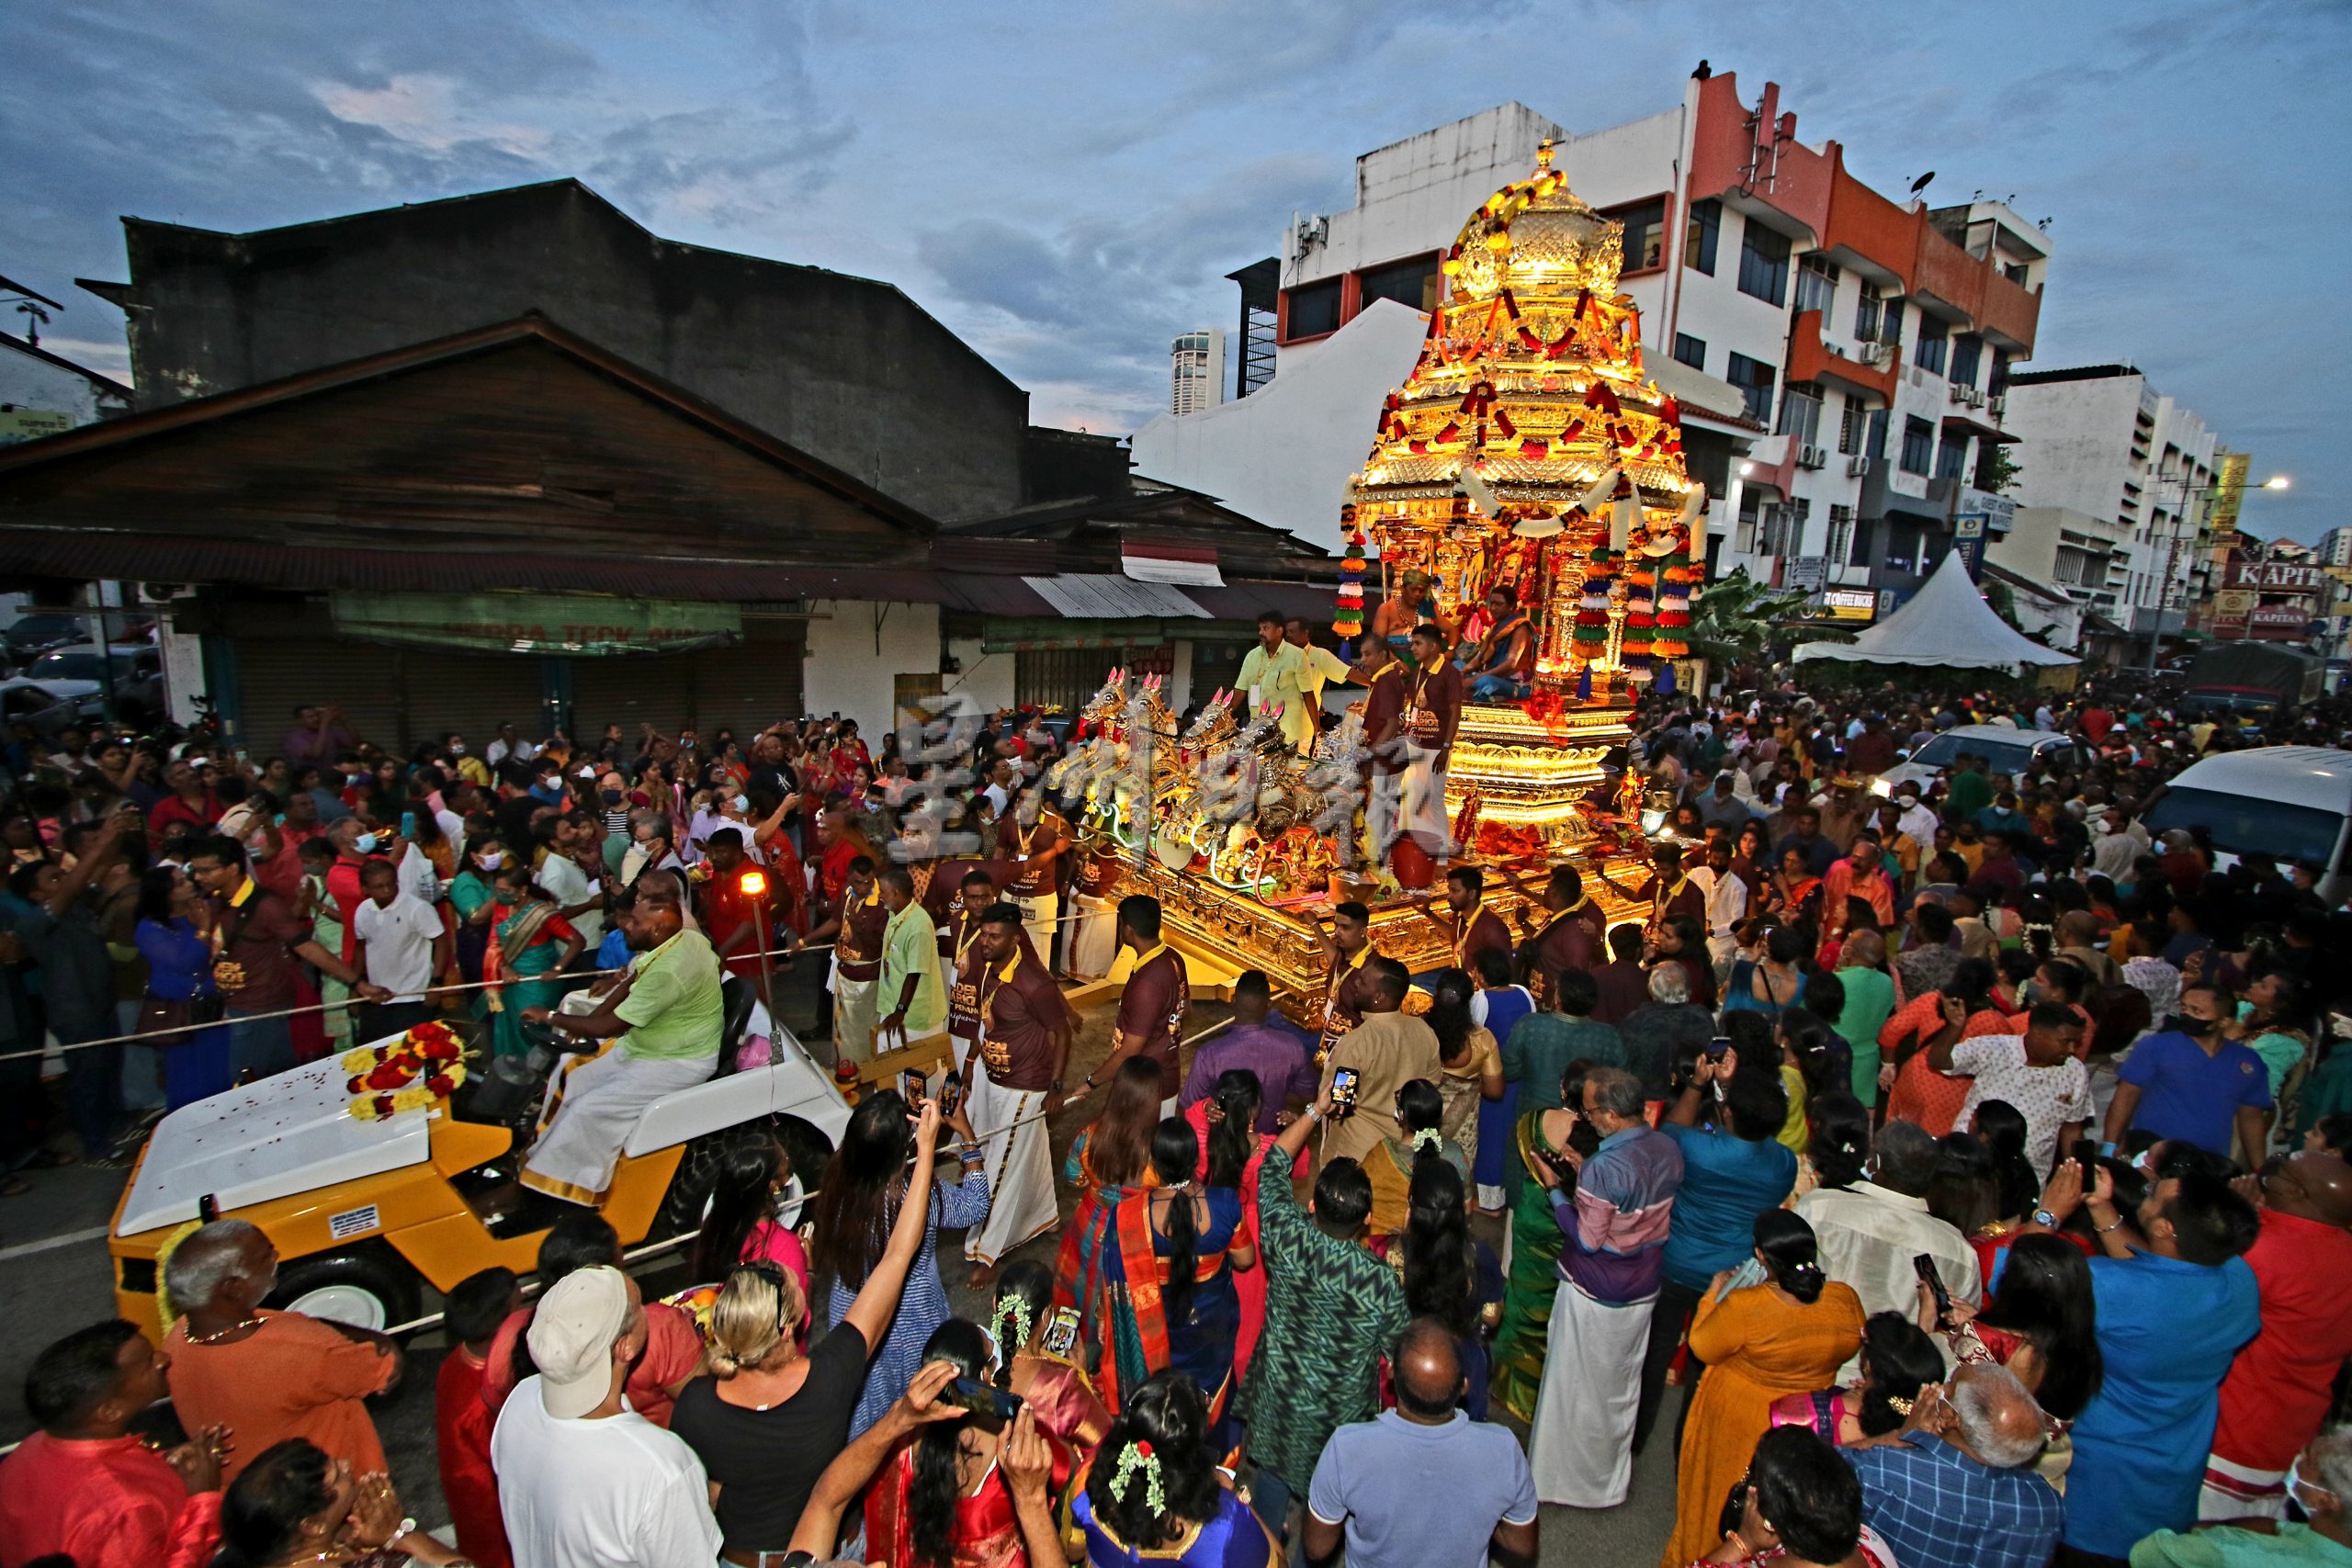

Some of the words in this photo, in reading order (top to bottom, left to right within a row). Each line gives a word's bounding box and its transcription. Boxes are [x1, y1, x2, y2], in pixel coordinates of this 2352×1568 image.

[1981, 496, 1998, 511] GUEST
[1997, 501, 2015, 515] HOUSE
[1831, 592, 1854, 607] COFFEE
[1854, 593, 1874, 608] BUCKS
[2253, 613, 2303, 624] KAPITAN
